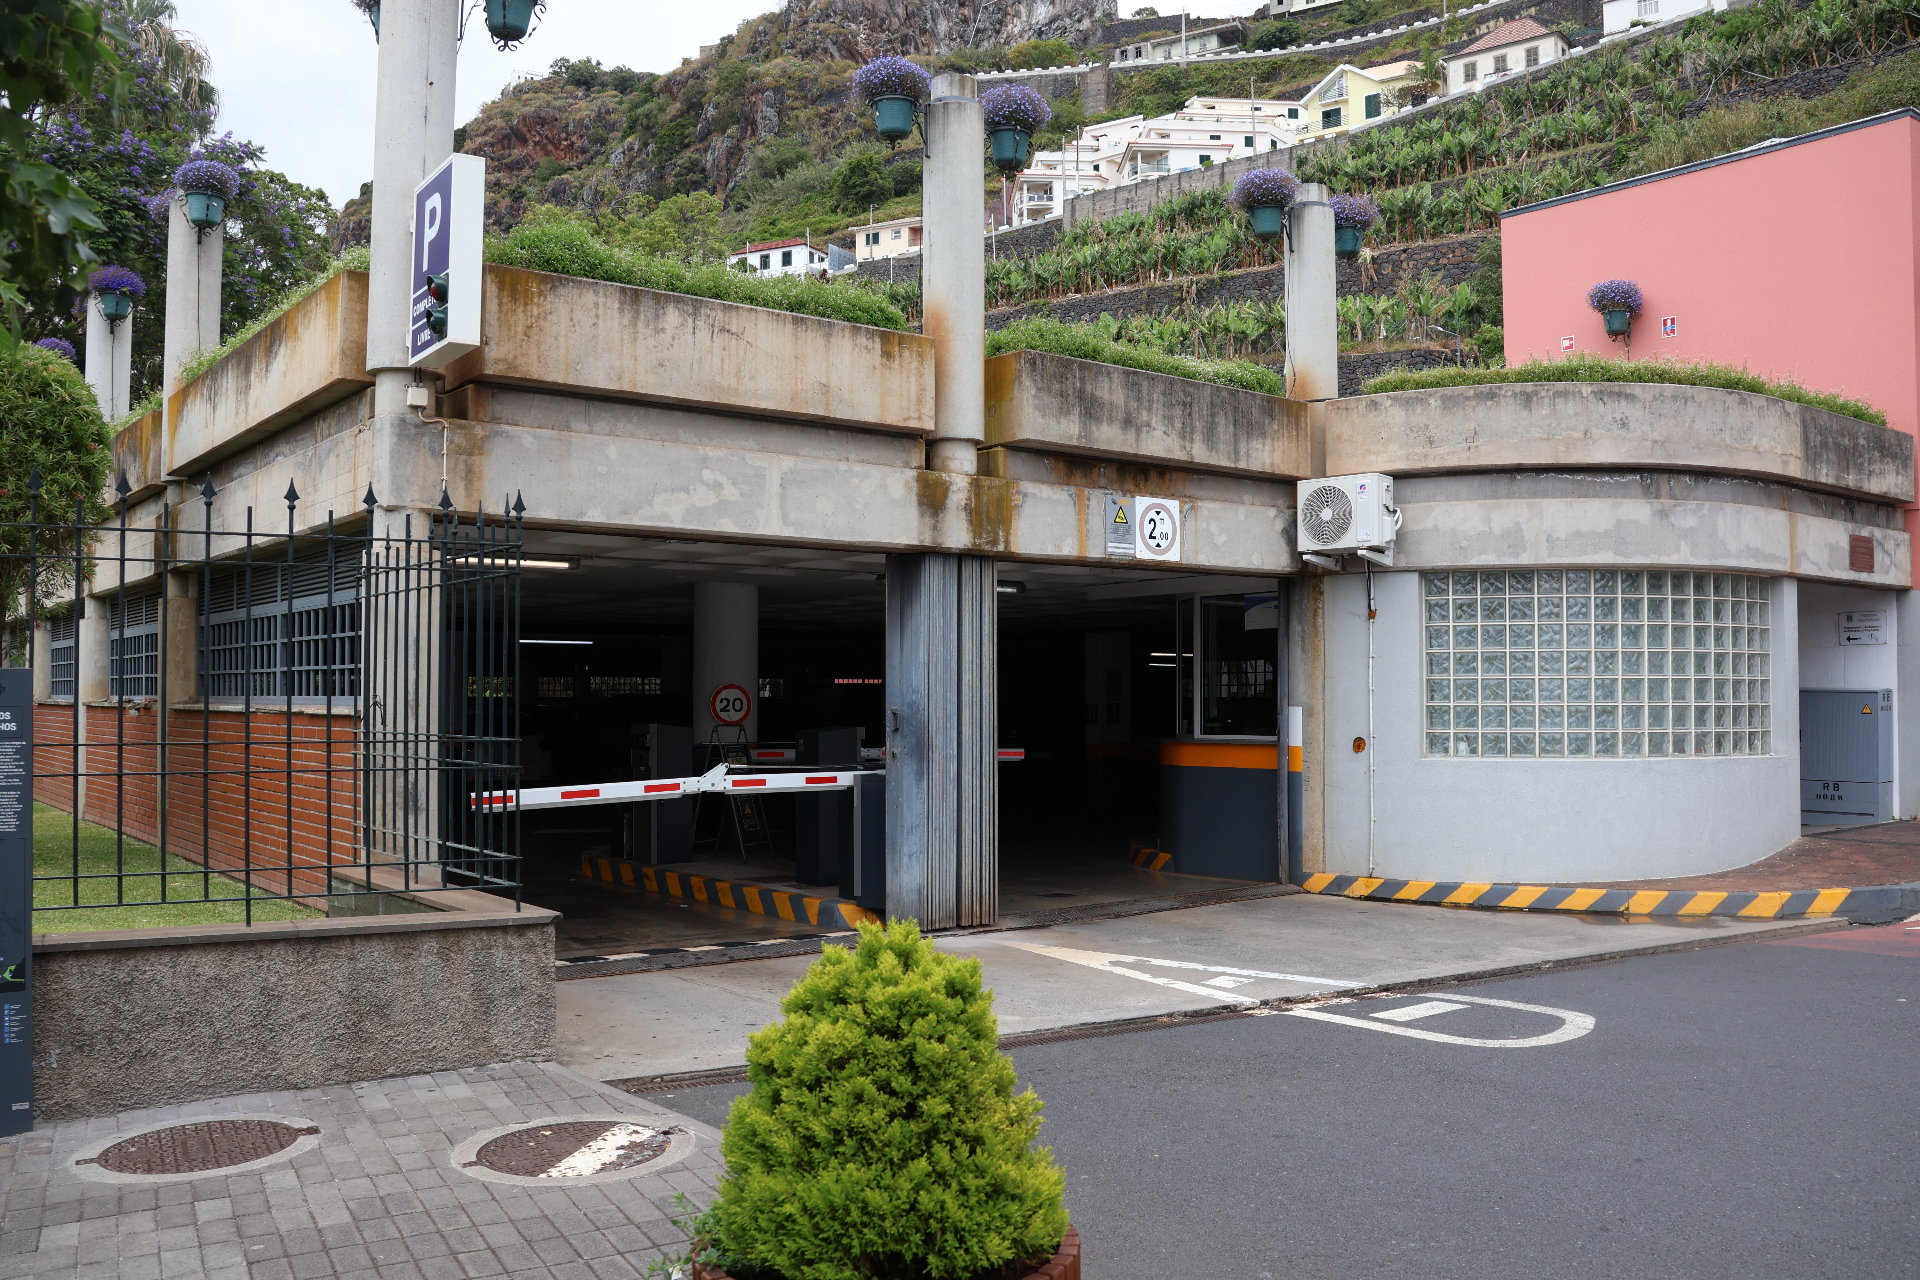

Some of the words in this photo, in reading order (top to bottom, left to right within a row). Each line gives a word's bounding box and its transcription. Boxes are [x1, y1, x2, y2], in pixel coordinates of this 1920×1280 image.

[422, 192, 442, 273] P
[719, 697, 744, 713] 20
[1816, 793, 1843, 801] 0086
